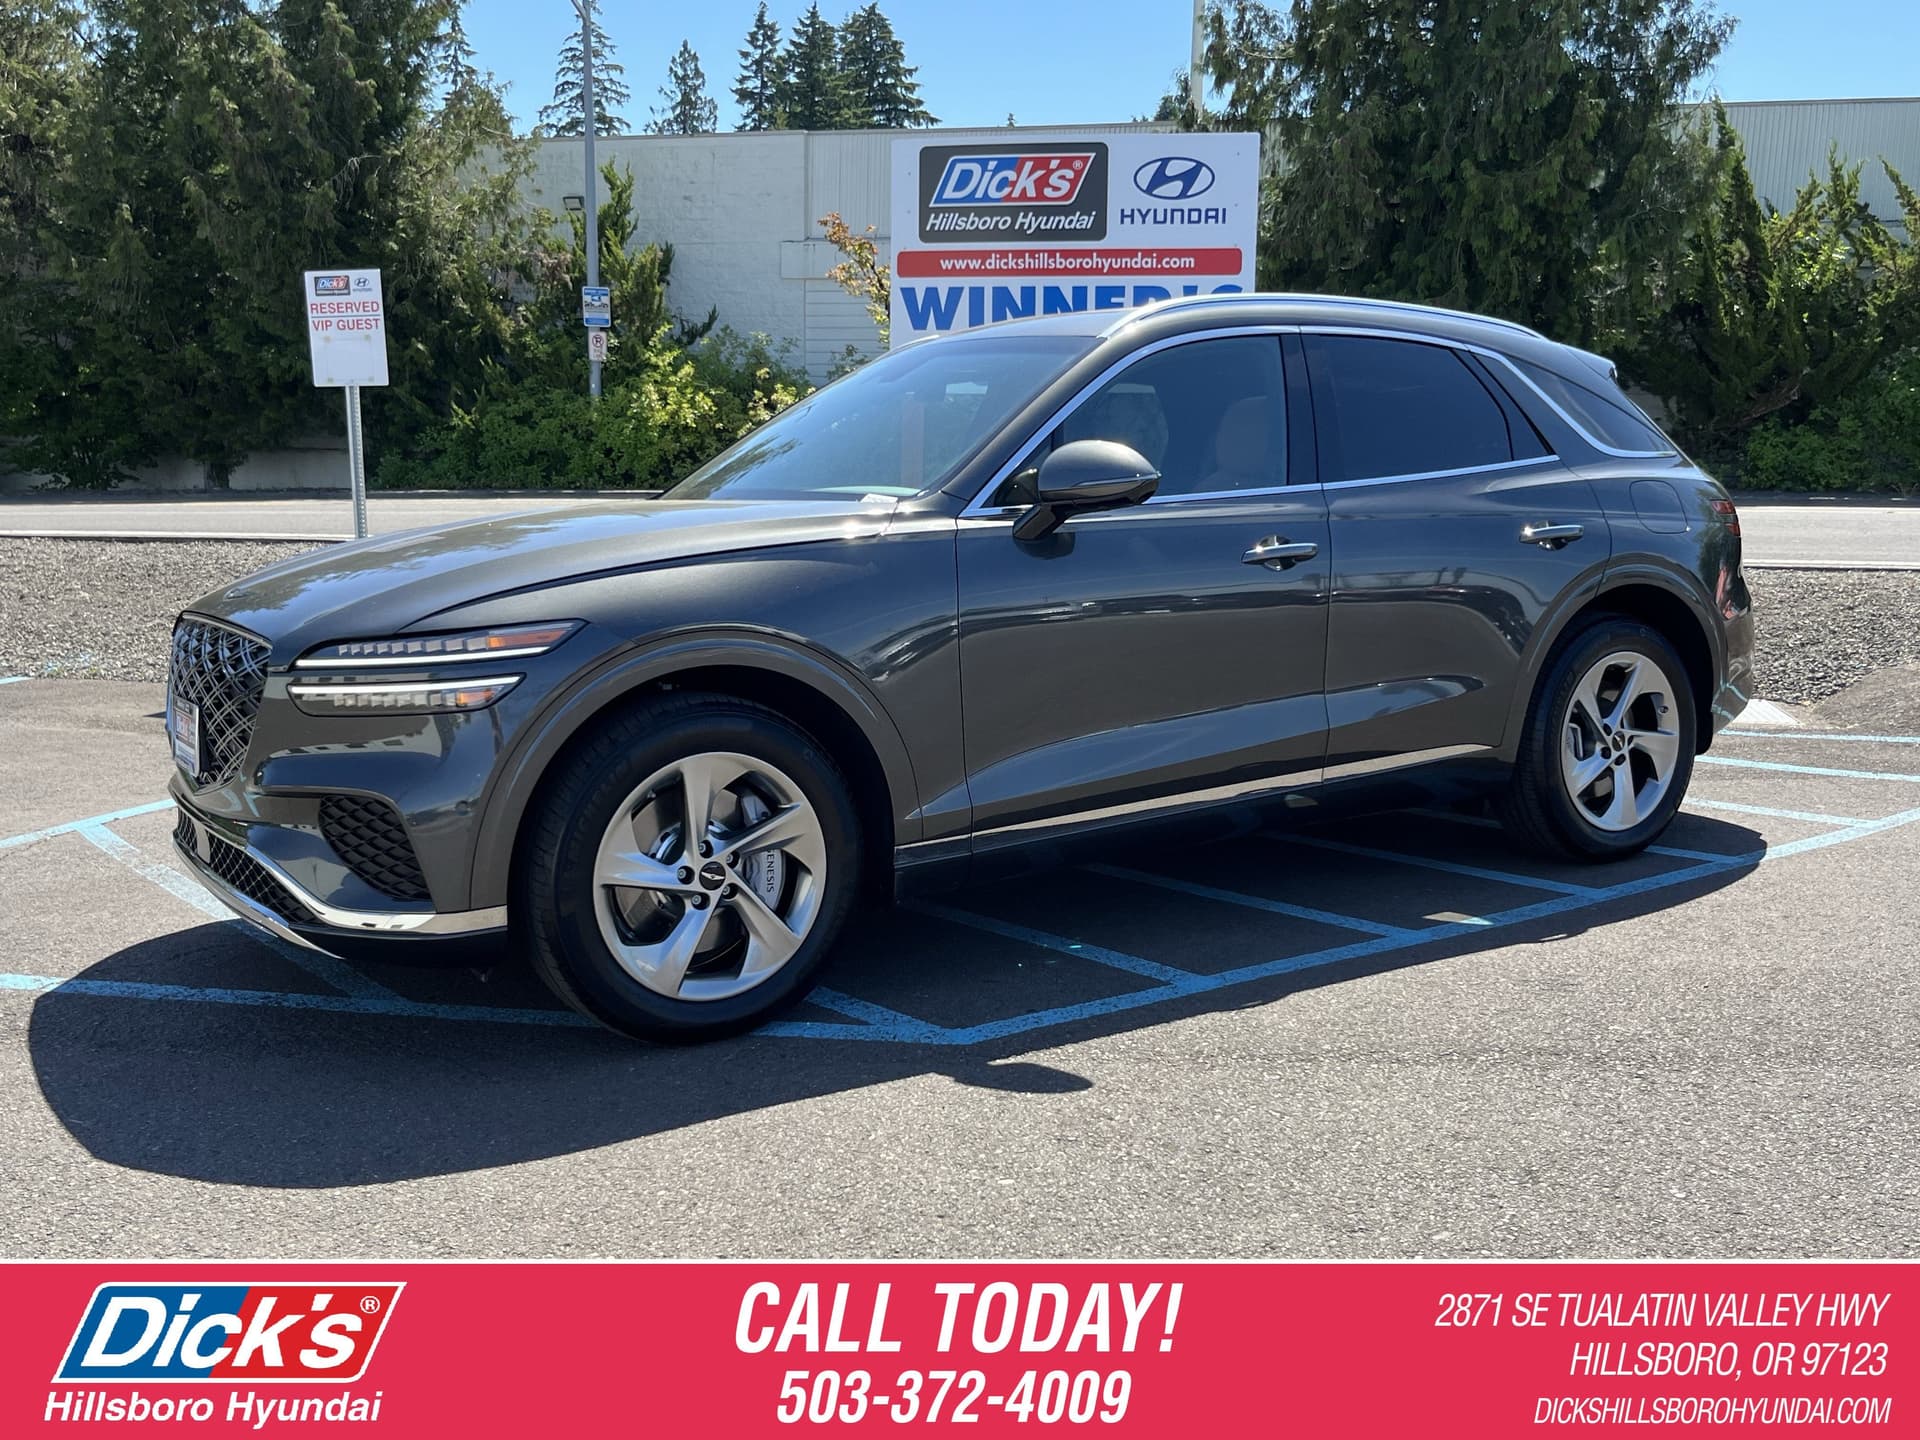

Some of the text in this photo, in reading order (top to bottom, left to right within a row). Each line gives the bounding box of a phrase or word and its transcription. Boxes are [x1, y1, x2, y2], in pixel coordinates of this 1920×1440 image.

[925, 211, 1097, 234] Hillsboro Hyundai
[1120, 208, 1227, 225] HYUNDAI
[940, 253, 1195, 273] www.dickshillsborohyundai.com
[310, 301, 380, 314] RESERVED
[312, 318, 381, 331] VIP GUEST
